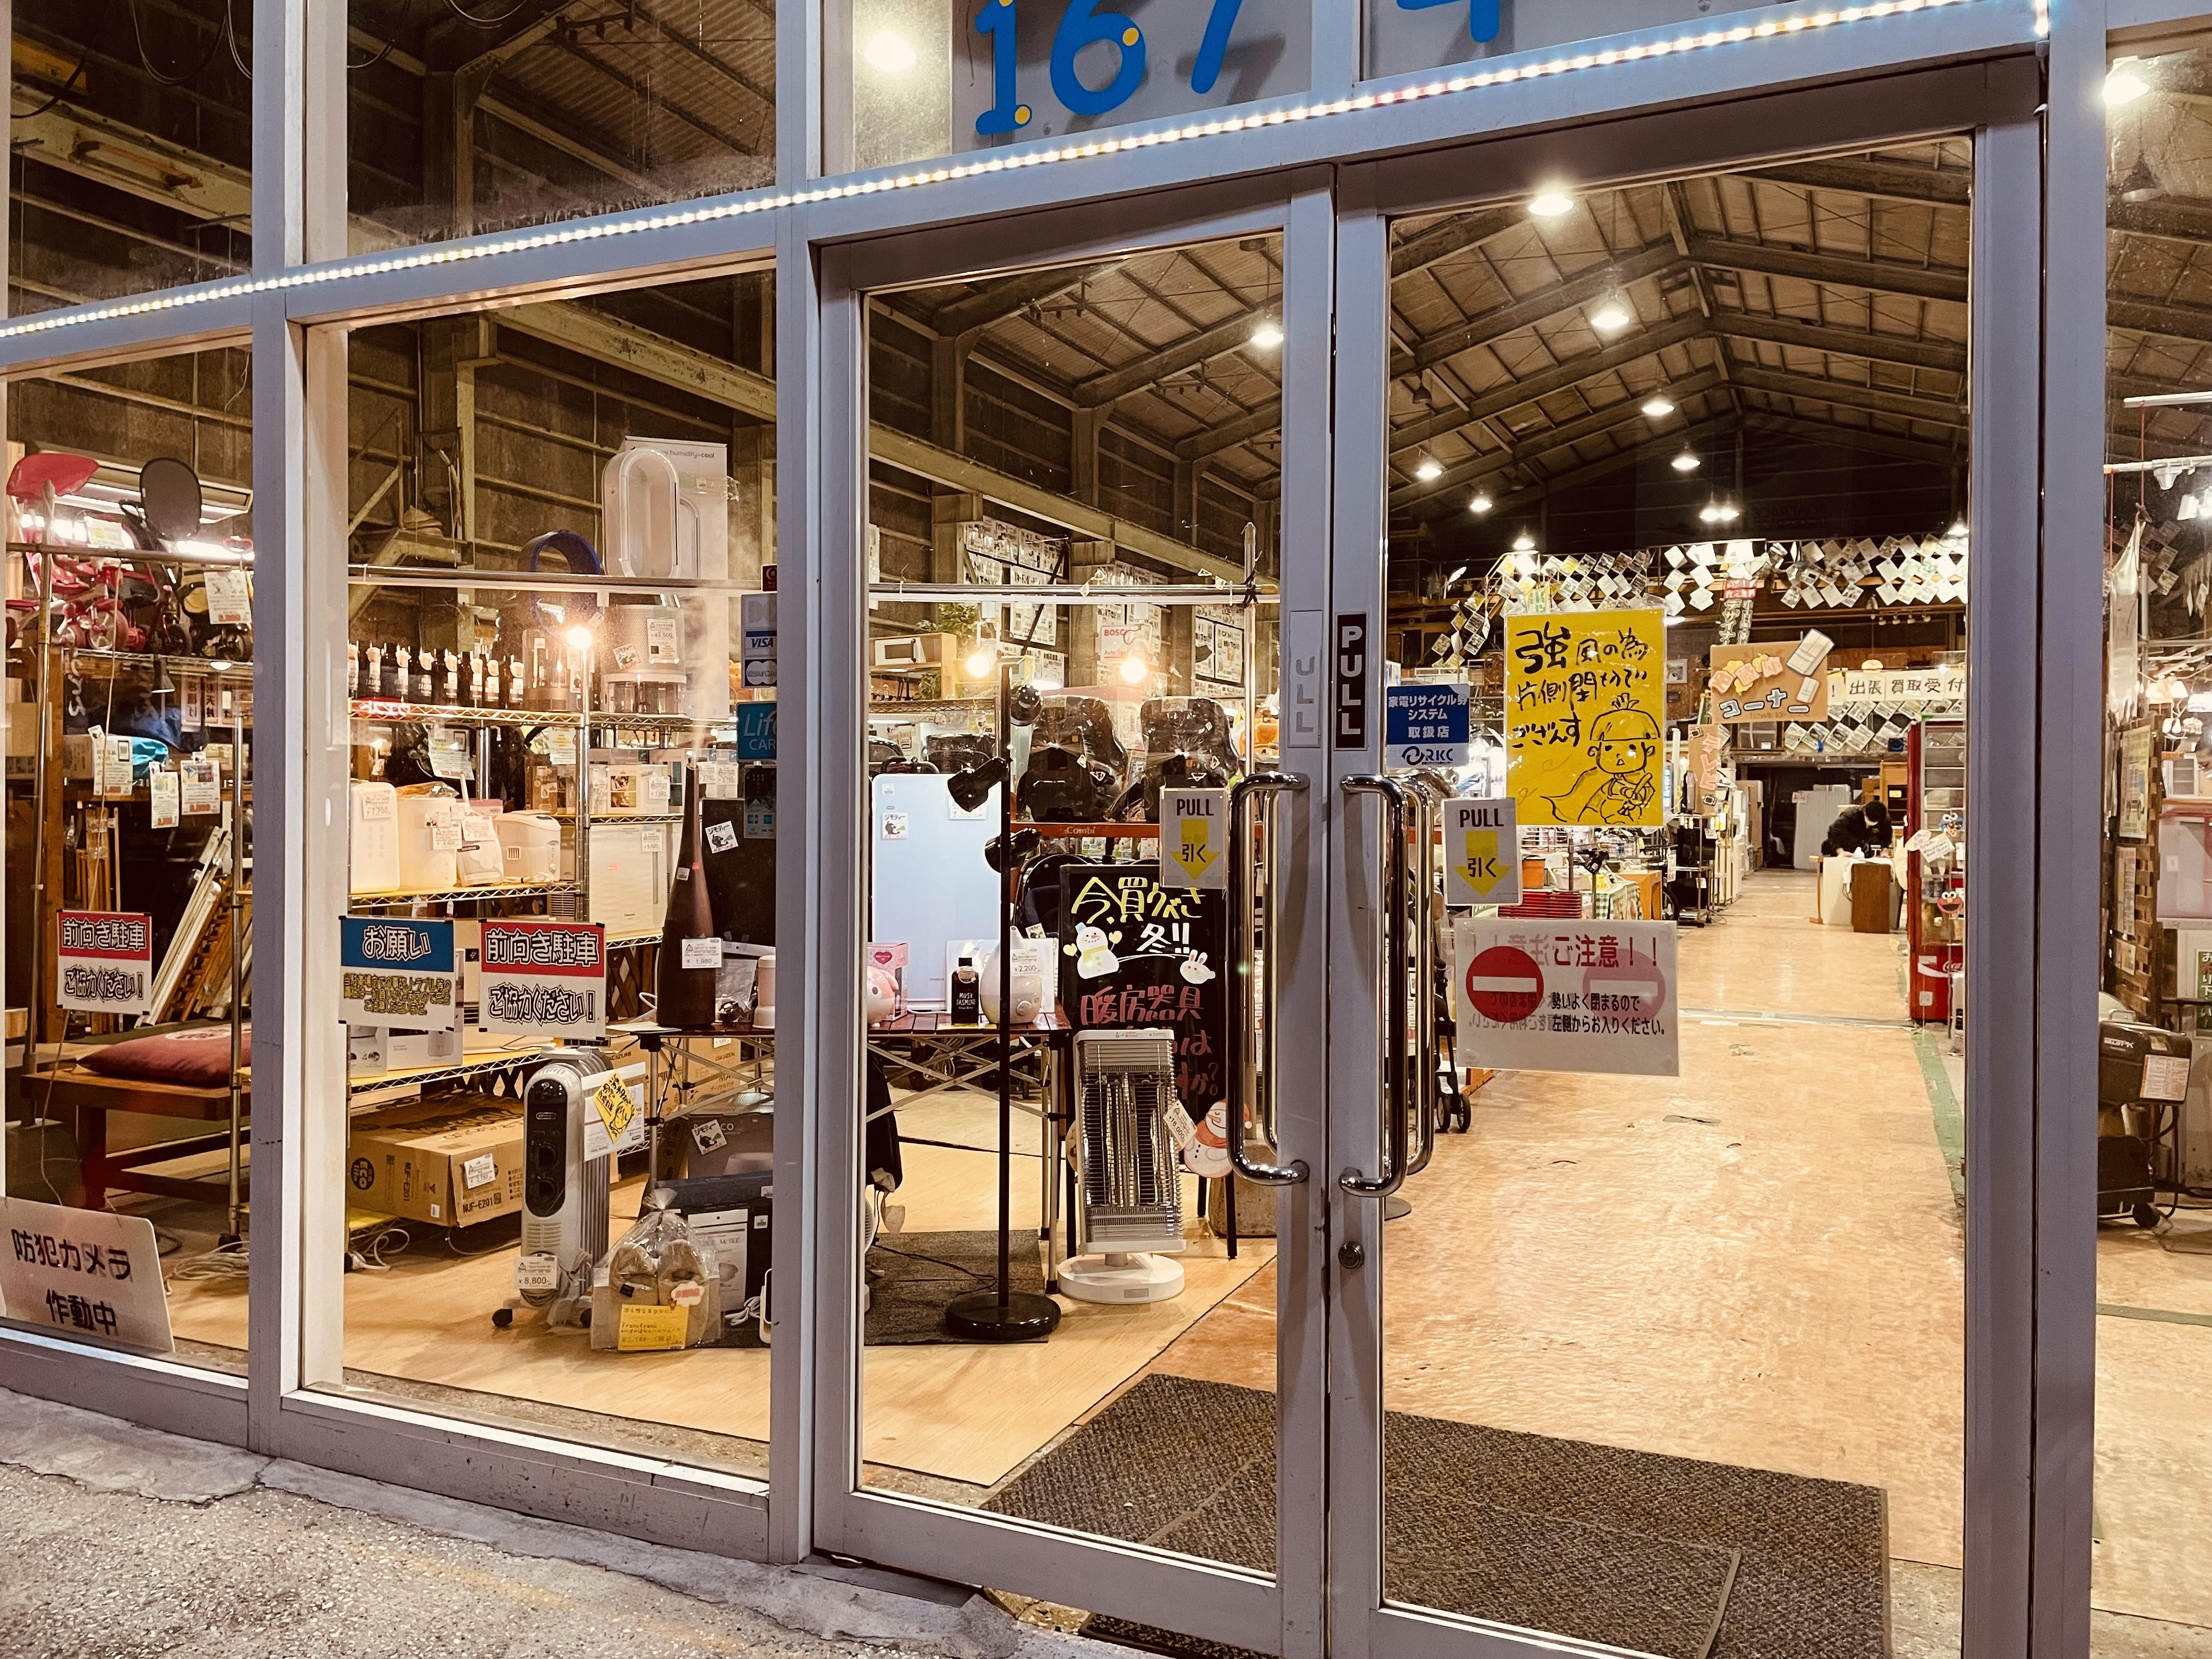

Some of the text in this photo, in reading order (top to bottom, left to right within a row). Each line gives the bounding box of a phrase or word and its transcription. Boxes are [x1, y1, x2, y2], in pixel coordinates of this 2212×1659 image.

[751, 637, 774, 648] VISA
[1515, 622, 1650, 674] 強風の為
[1340, 626, 1363, 735] PULL
[1388, 693, 1468, 708] 家電リサイクル券
[1720, 688, 1810, 719] コーナー
[1408, 709, 1448, 720] システム
[1408, 726, 1449, 738] 取扱店
[1426, 748, 1453, 761] RKC
[1176, 799, 1215, 816] PULL
[1459, 808, 1505, 828] PULL
[1182, 843, 1207, 863] 引く
[1467, 856, 1497, 878] 引く
[62, 918, 146, 951] 前向き駐車
[363, 926, 431, 961] お願い
[486, 928, 599, 967] 前向き駐車
[1080, 984, 1205, 1026] 暖房器具
[1551, 992, 1640, 1013] 勢いよく閉まるので
[1553, 1016, 1666, 1035] 左側からお入りください。
[462, 1197, 493, 1214] NUF-E201
[11, 1228, 131, 1280] 防犯カメラ
[46, 1288, 117, 1335] 作動中
